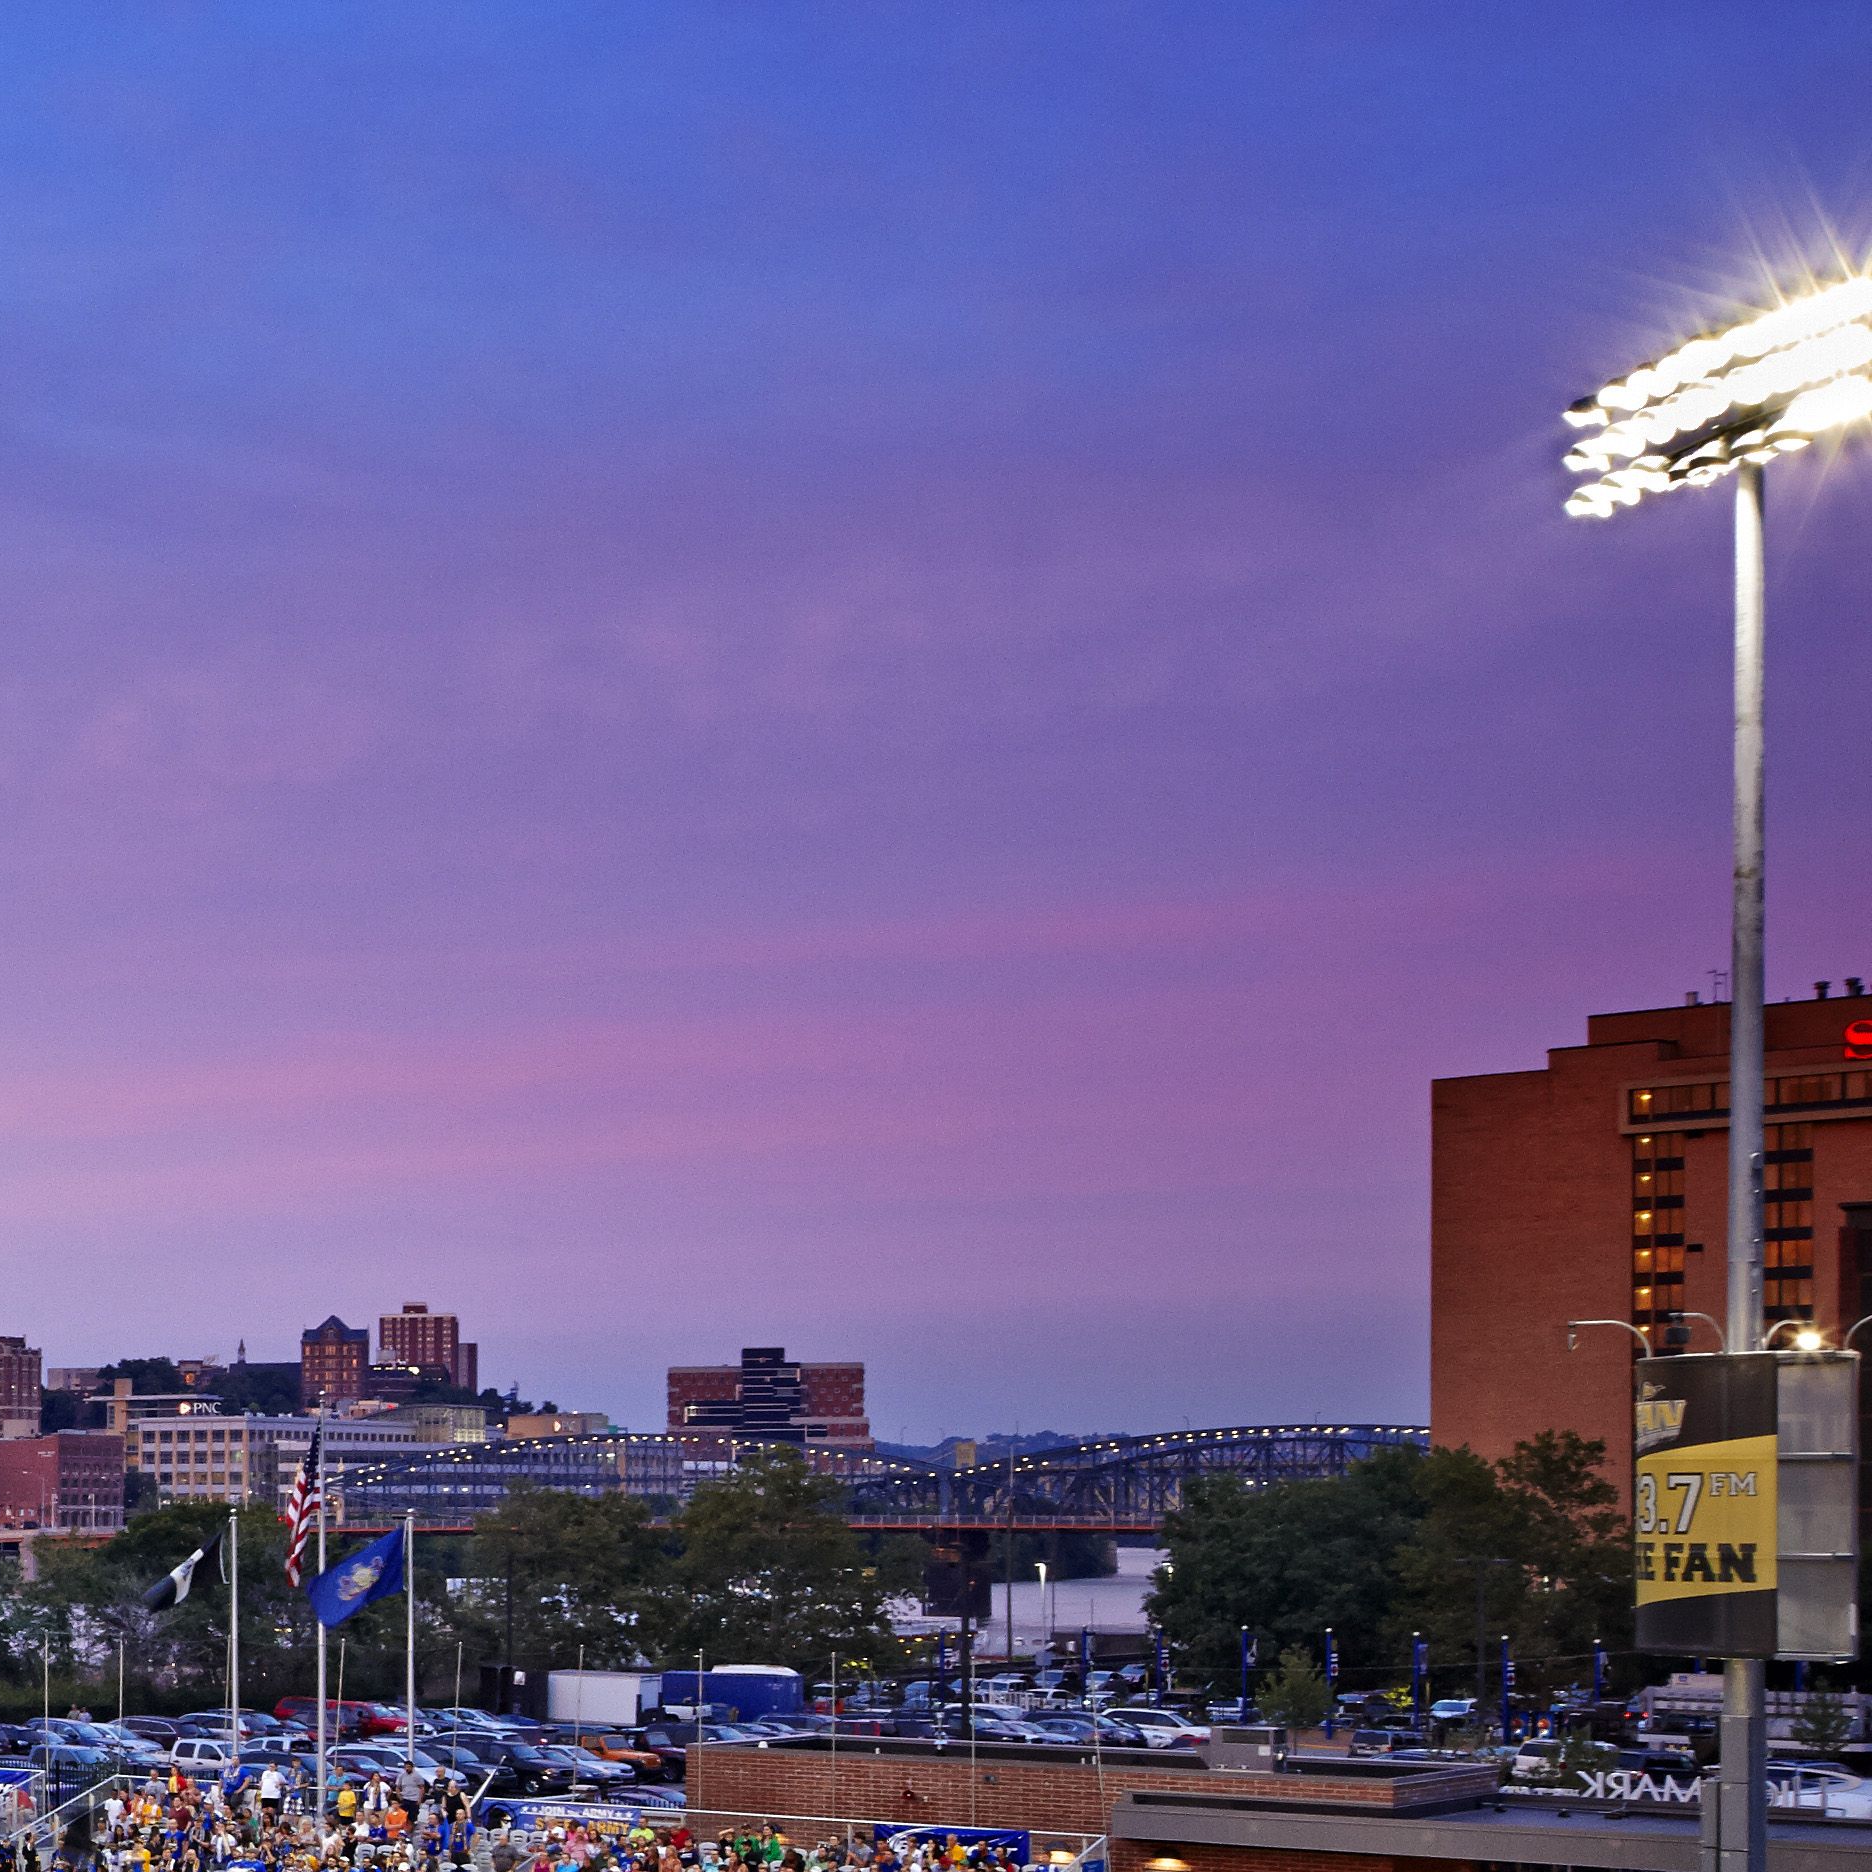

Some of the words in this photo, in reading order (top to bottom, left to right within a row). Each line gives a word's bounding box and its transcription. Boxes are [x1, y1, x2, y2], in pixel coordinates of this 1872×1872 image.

[194, 1402, 221, 1413] PNC
[1709, 1472, 1757, 1496] FM
[1664, 1542, 1757, 1583] FAN
[541, 1806, 565, 1815] JOIN
